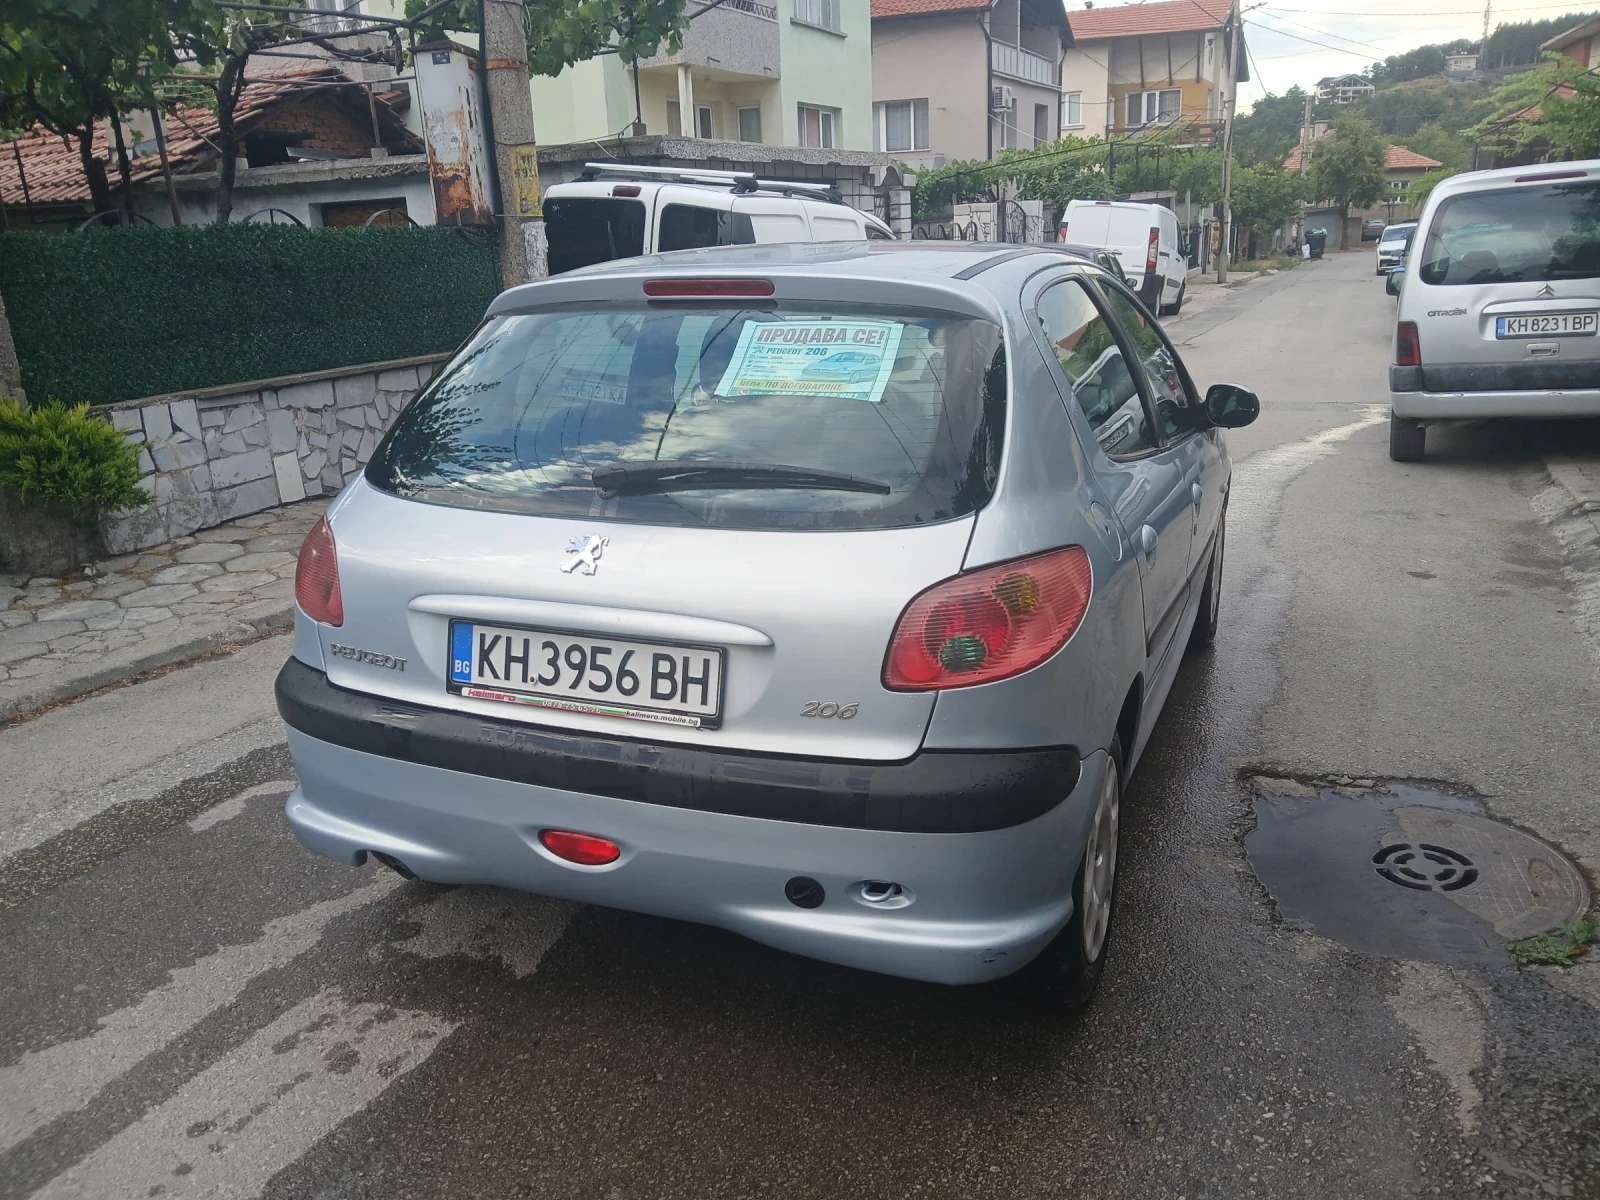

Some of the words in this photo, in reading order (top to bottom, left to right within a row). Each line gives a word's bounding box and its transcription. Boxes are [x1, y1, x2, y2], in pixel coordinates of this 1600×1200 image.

[1531, 317, 1568, 332] 8231
[1572, 316, 1594, 331] BP
[757, 328, 847, 345] ПРОДАВА
[852, 328, 886, 345] СЕ!
[766, 347, 802, 355] PEUGEOT
[805, 347, 828, 356] 206
[780, 382, 844, 390] ДОГОВАРЯНЕ
[330, 642, 408, 672] PEUGEOT
[454, 660, 470, 674] BG
[538, 641, 639, 696] 3956
[650, 652, 711, 706] BH
[799, 699, 860, 720] 206
[626, 710, 699, 726] kalimero.mobile.bg
